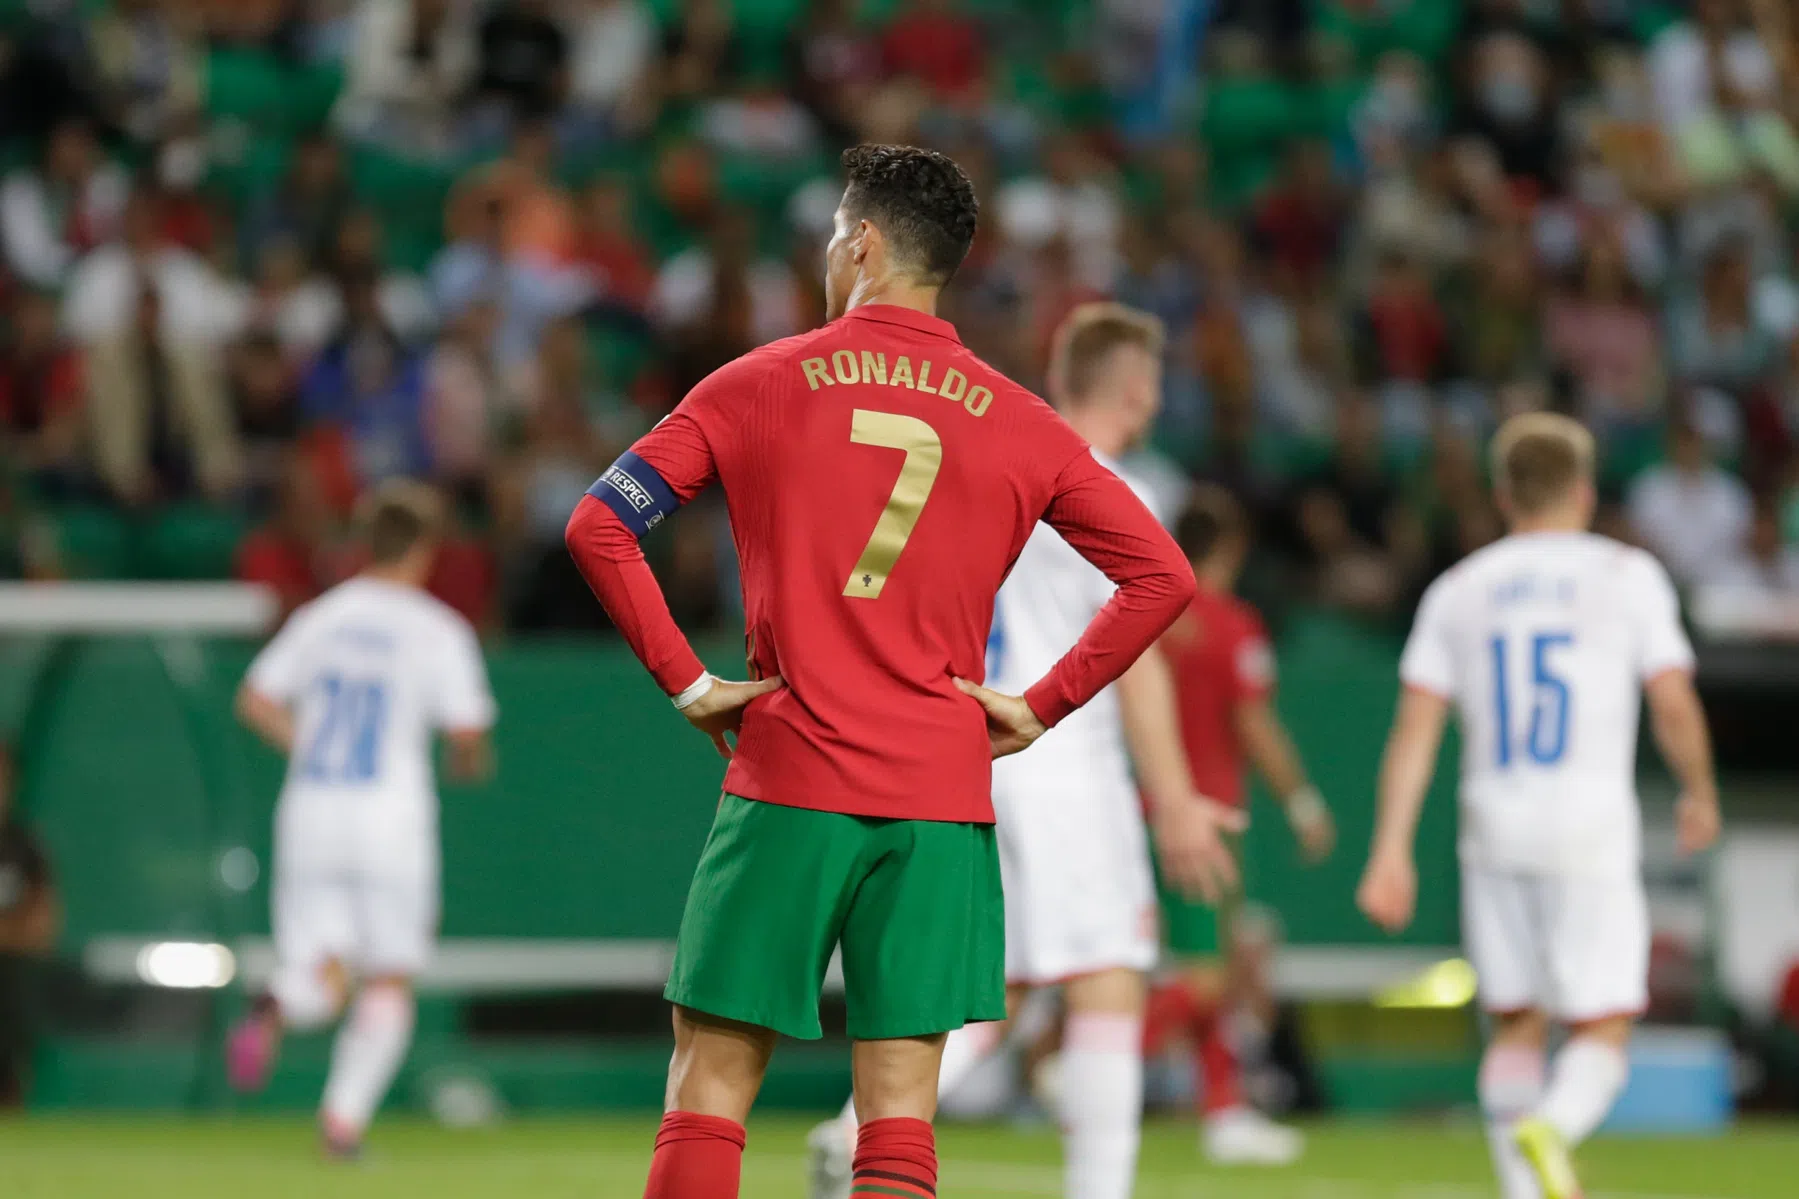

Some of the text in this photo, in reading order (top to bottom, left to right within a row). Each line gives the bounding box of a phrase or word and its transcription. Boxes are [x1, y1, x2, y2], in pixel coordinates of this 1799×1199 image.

[801, 350, 994, 417] RONALDO
[610, 472, 651, 509] RESPECT
[842, 408, 942, 599] 7
[1491, 631, 1573, 769] 15
